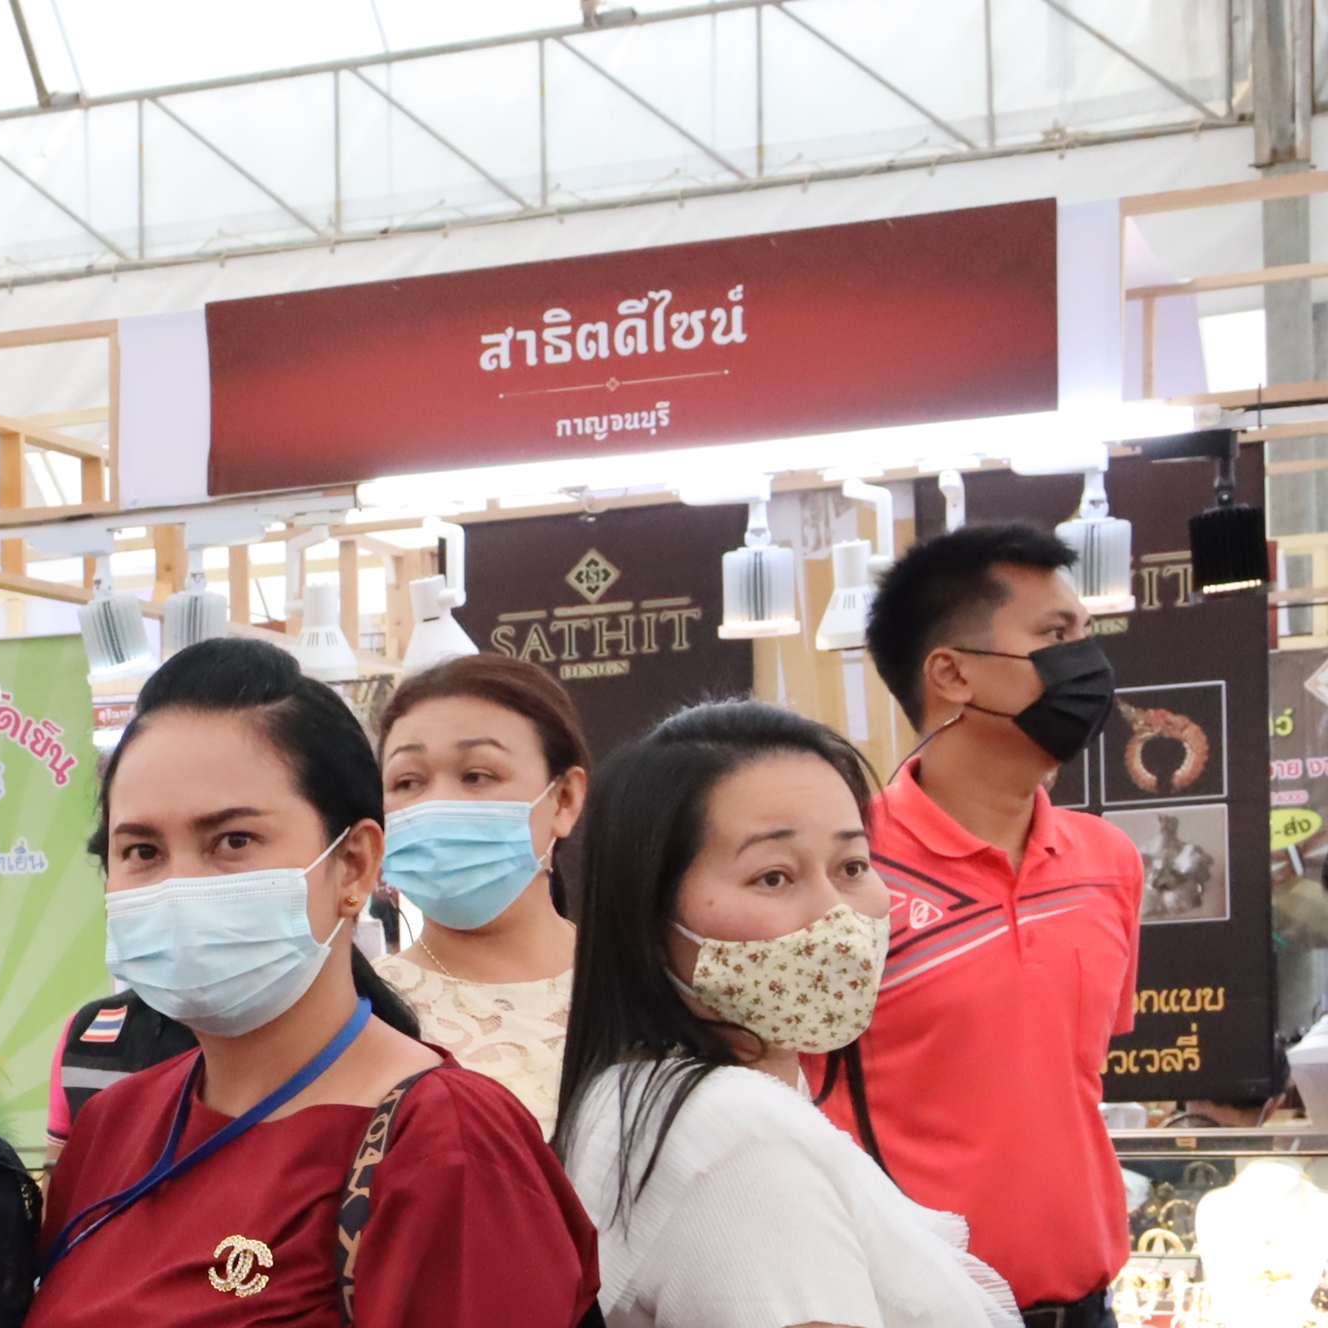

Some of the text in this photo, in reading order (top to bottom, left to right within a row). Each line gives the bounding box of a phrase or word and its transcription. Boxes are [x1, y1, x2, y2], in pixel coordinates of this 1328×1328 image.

[479, 284, 747, 371] สาธิตดีไซน์
[556, 401, 671, 441] กาญจนบุรี
[491, 607, 702, 663] SATHIT
[560, 660, 630, 680] DESIGN
